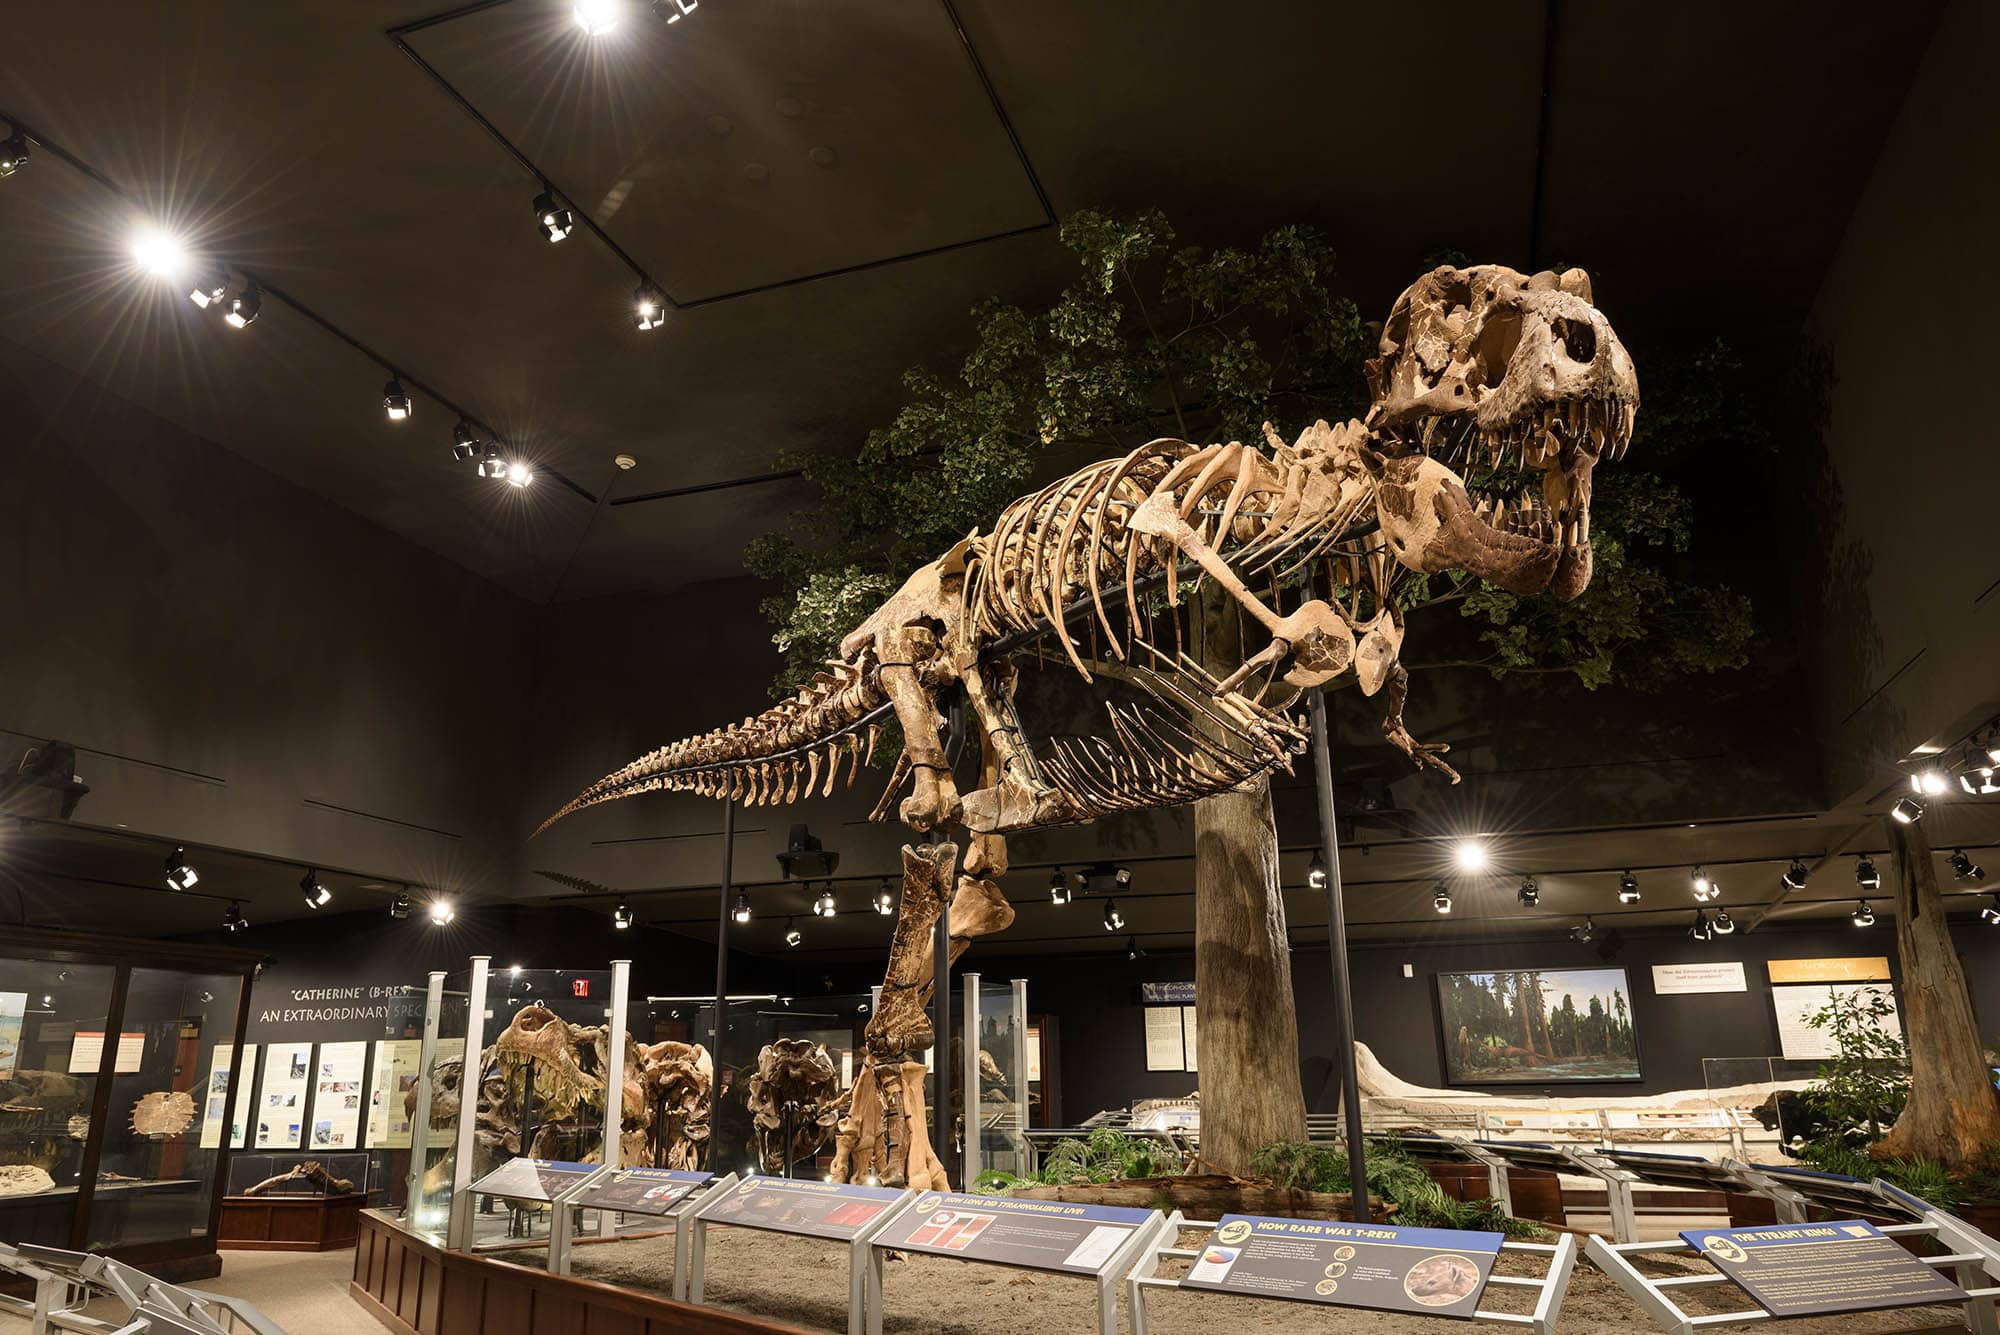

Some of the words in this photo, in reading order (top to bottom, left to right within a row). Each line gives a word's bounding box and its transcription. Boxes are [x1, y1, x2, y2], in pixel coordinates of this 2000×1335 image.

[260, 1009, 280, 1023] AN
[283, 1005, 389, 1022] EXTRAORDINARY
[1257, 1221, 1288, 1231] HOW
[1288, 1224, 1322, 1234] RARE
[1325, 1227, 1352, 1236] WAS
[1731, 1233, 1757, 1242] THE
[1756, 1229, 1803, 1241] TYRANT
